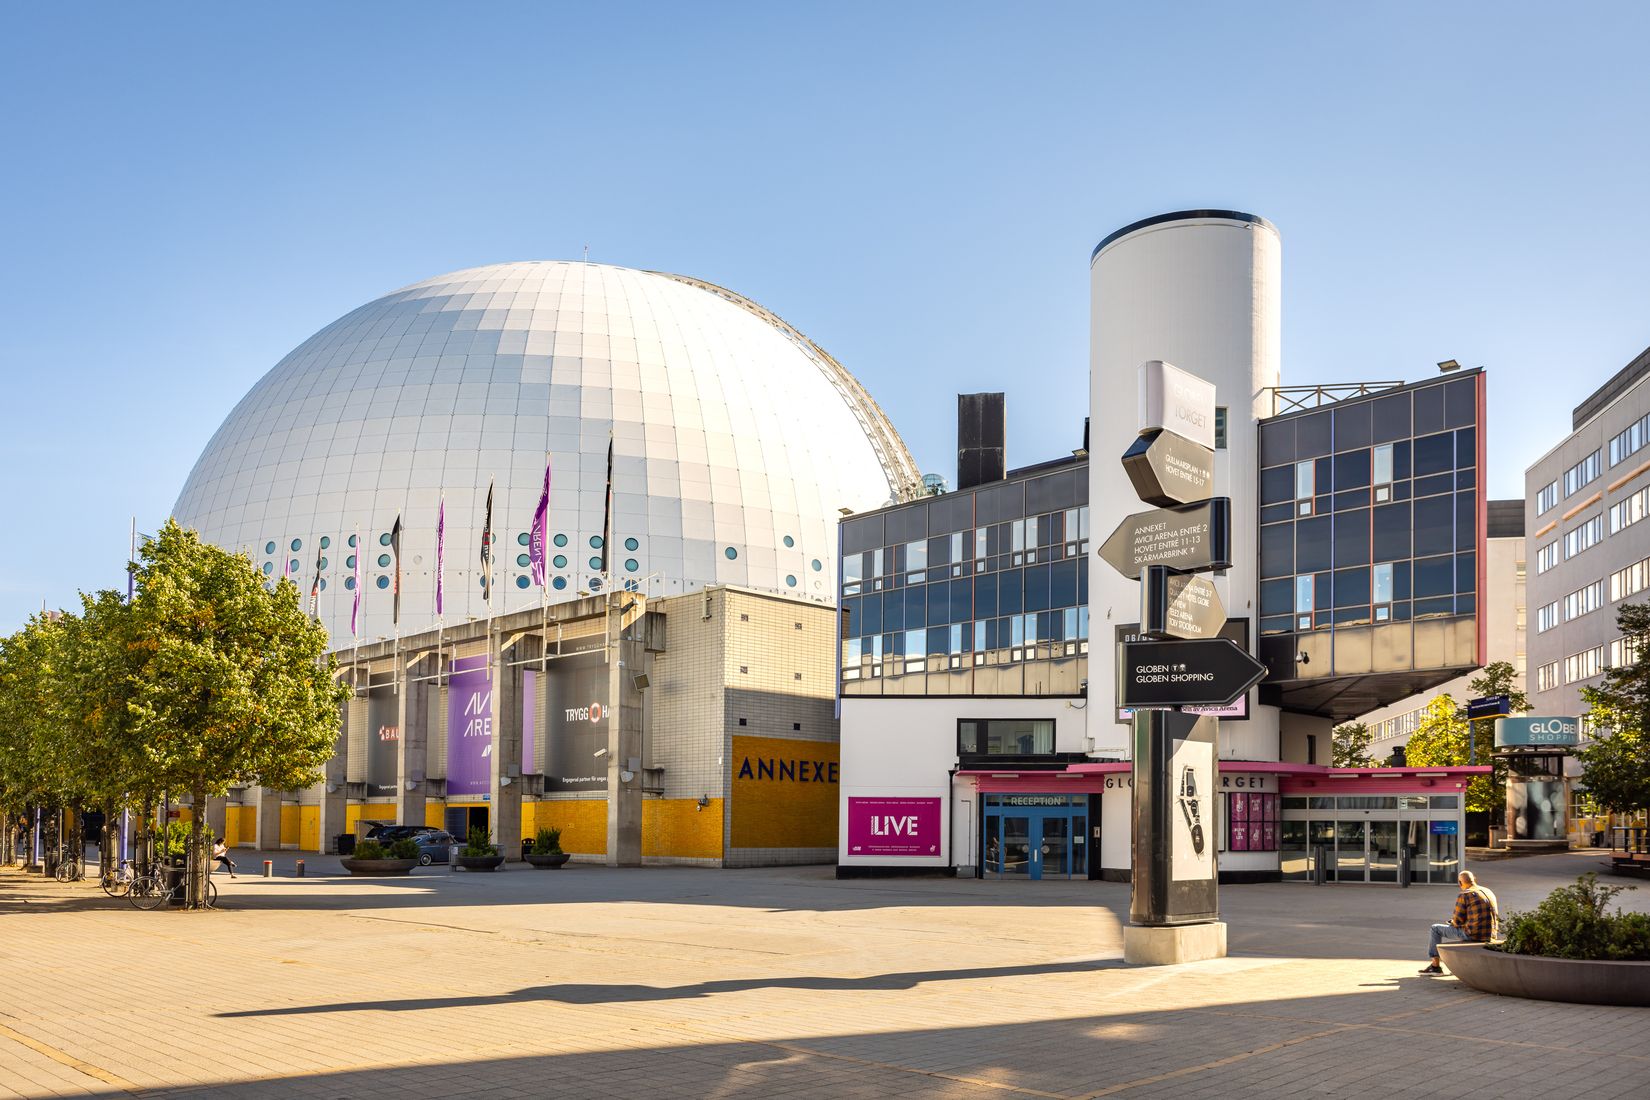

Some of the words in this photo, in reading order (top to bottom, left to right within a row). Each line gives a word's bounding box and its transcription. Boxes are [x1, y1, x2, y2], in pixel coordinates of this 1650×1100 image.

[1134, 522, 1167, 535] ANNEXET
[1134, 534, 1153, 545] AVICII
[1154, 531, 1179, 541] ARENA
[1180, 524, 1201, 537] ENTRÉ
[1202, 524, 1208, 532] 2
[1134, 543, 1157, 555] HOVET
[1158, 538, 1179, 550] ENTRÉ
[1181, 536, 1201, 546] 11-13
[1134, 547, 1188, 565] SKÄRMARBRINK
[1136, 665, 1169, 674] GLOBEN
[1136, 675, 1169, 683] GLOBEN
[1170, 673, 1214, 683] SHOPPING
[565, 708, 589, 722] TRYGG
[738, 756, 838, 783] ANNEXE
[1011, 797, 1061, 805] RECEPTION
[874, 816, 918, 836] LIVE
